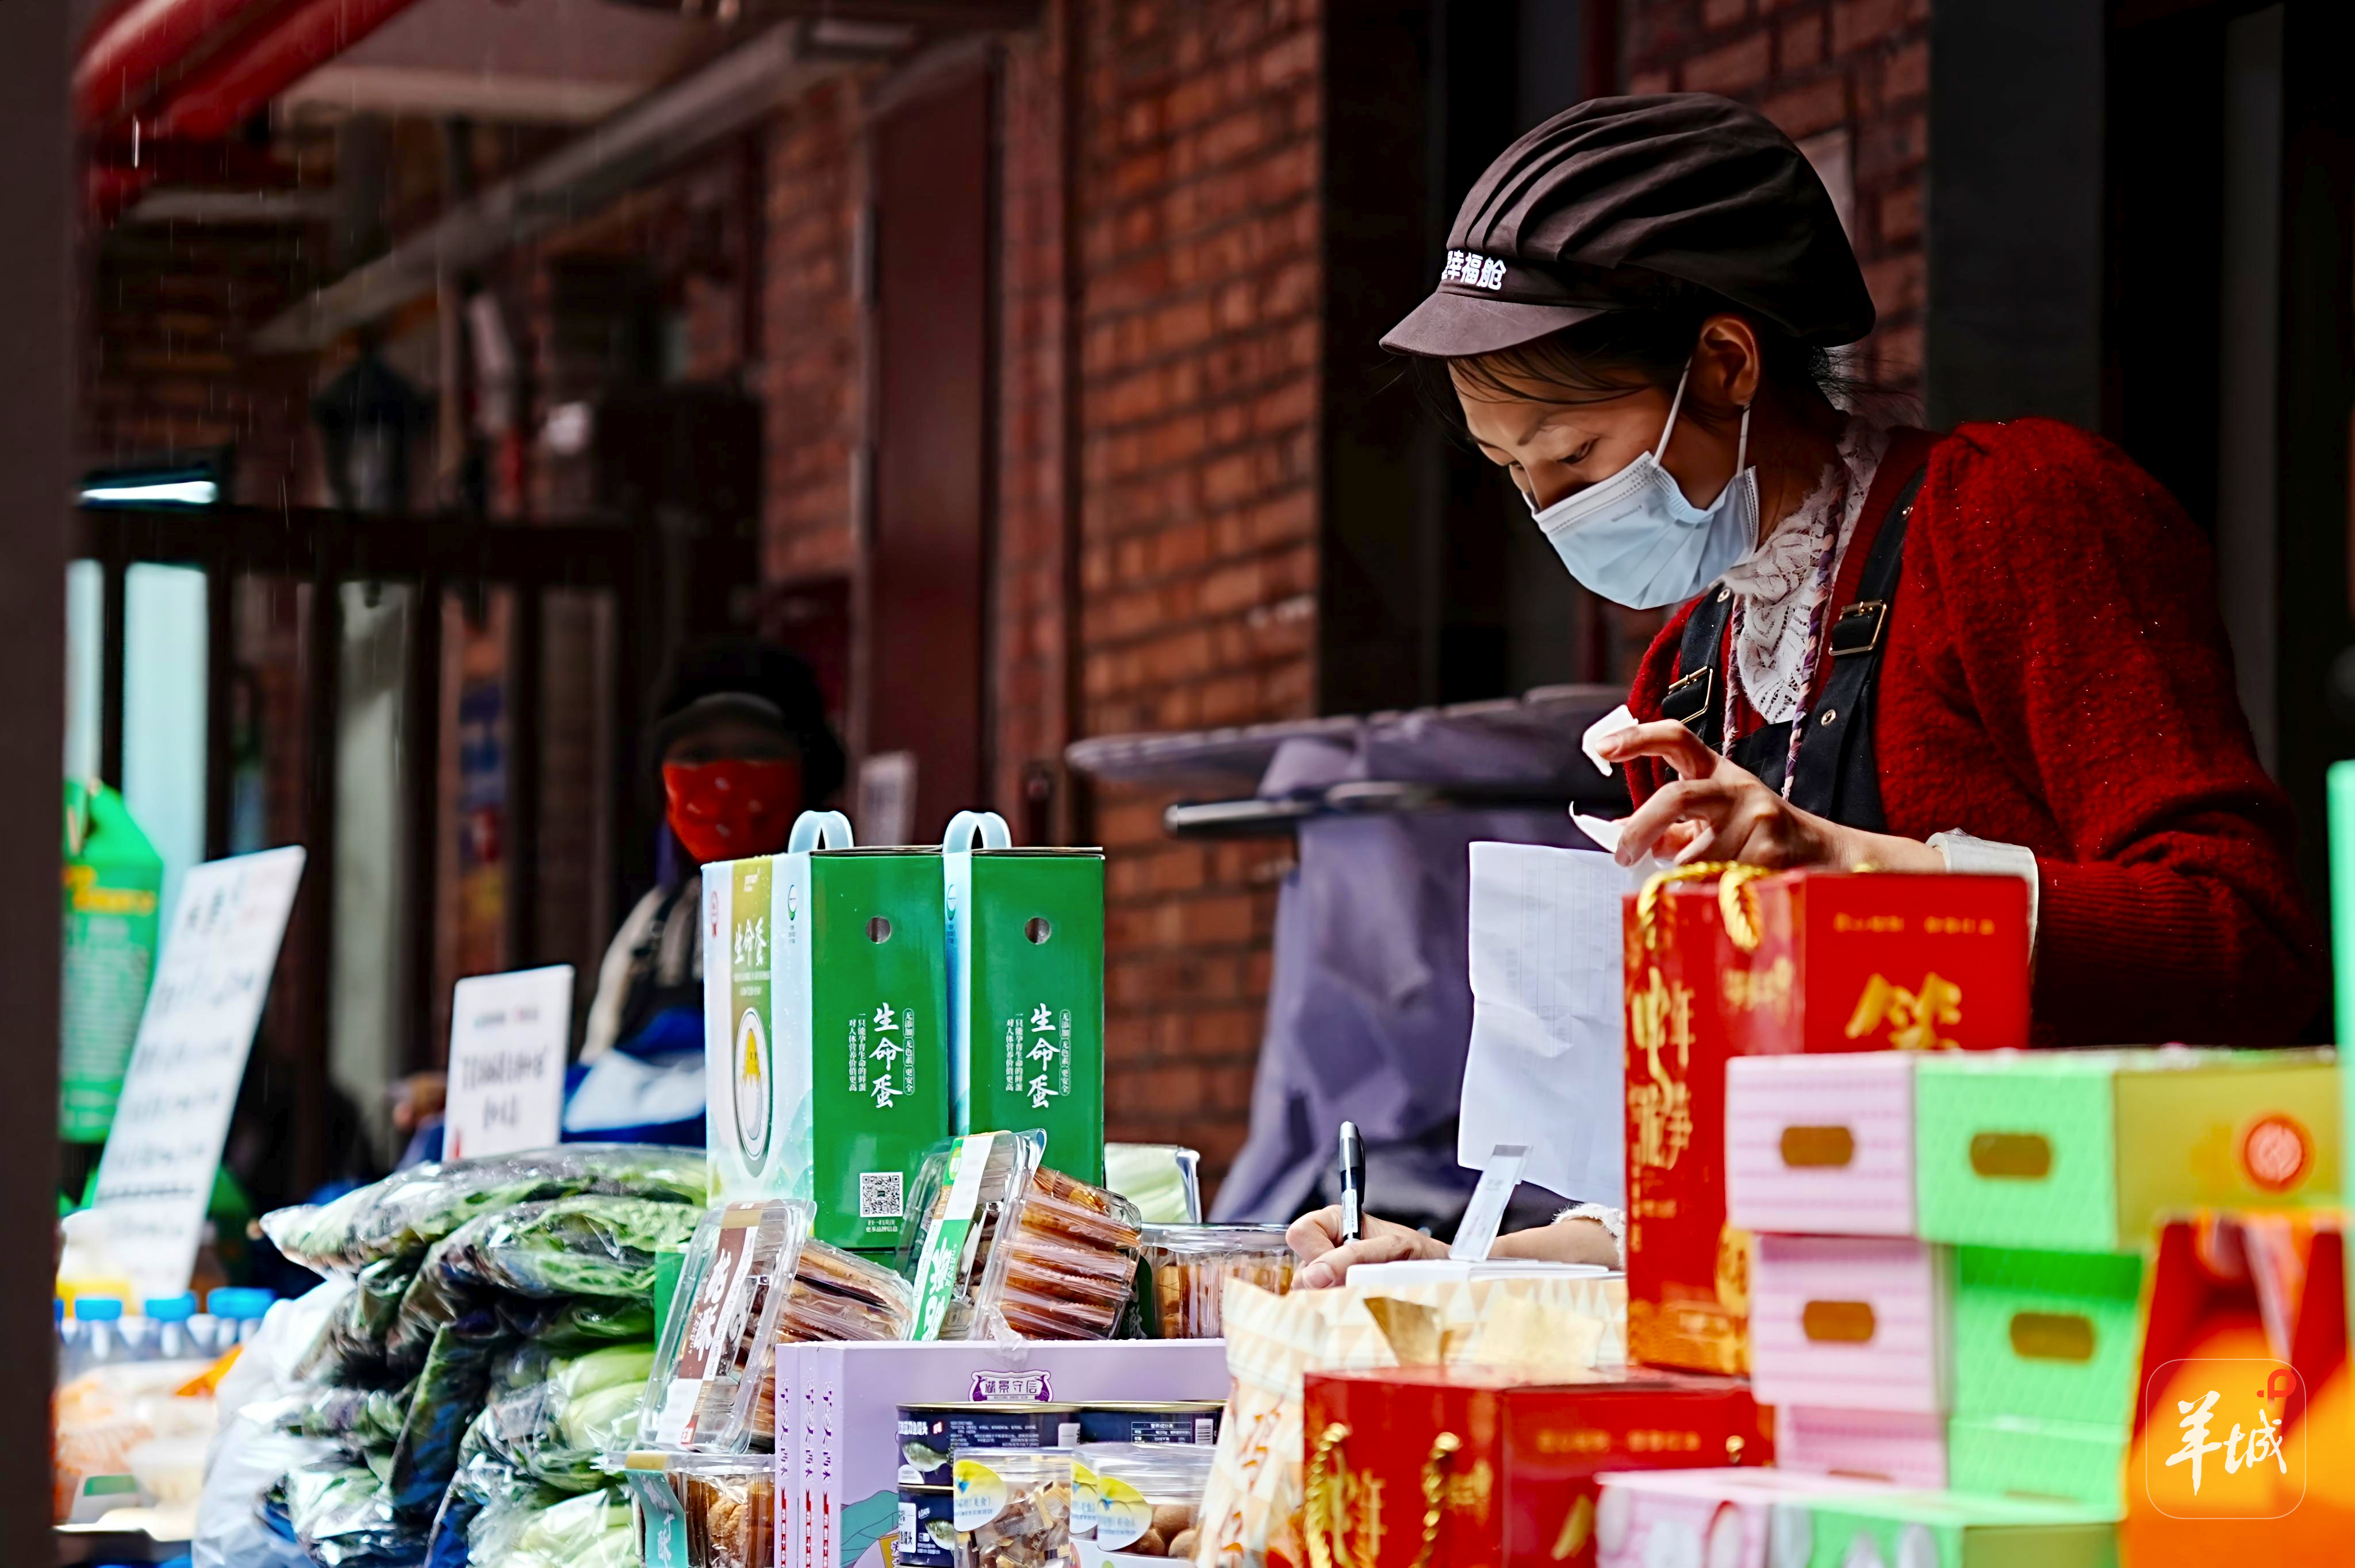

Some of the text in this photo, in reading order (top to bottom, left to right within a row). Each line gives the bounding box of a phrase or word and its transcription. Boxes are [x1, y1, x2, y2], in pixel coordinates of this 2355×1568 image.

[735, 917, 767, 966] 生命蛋
[869, 1002, 903, 1108] 生命蛋
[1026, 1003, 1060, 1108] 生命蛋
